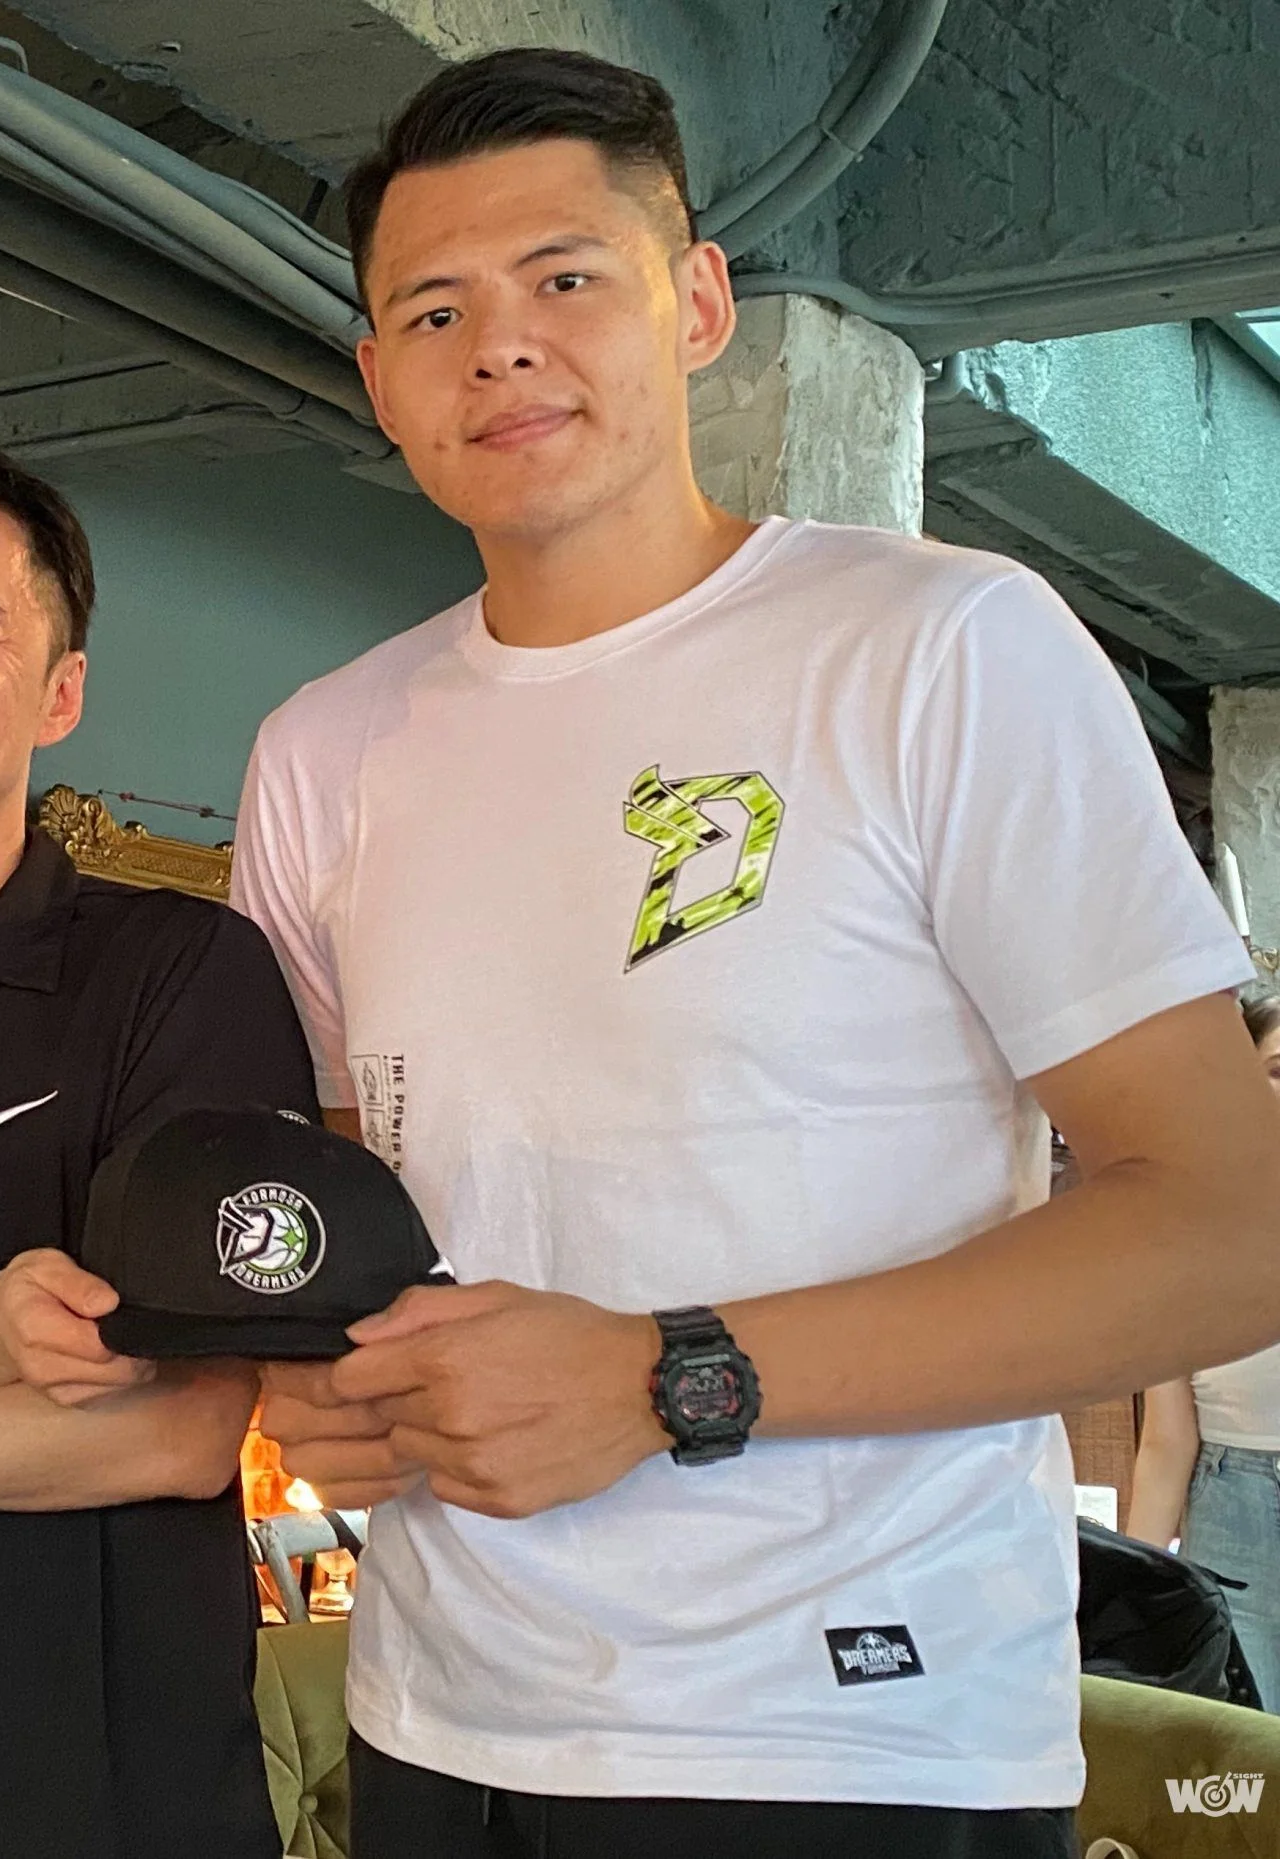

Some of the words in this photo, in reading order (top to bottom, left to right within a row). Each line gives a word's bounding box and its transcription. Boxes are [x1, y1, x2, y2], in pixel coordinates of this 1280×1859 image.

[391, 1054, 405, 1085] THE
[391, 1094, 405, 1152] POWER
[242, 1188, 304, 1212] FORMOSA
[235, 1264, 307, 1289] DREAMERS
